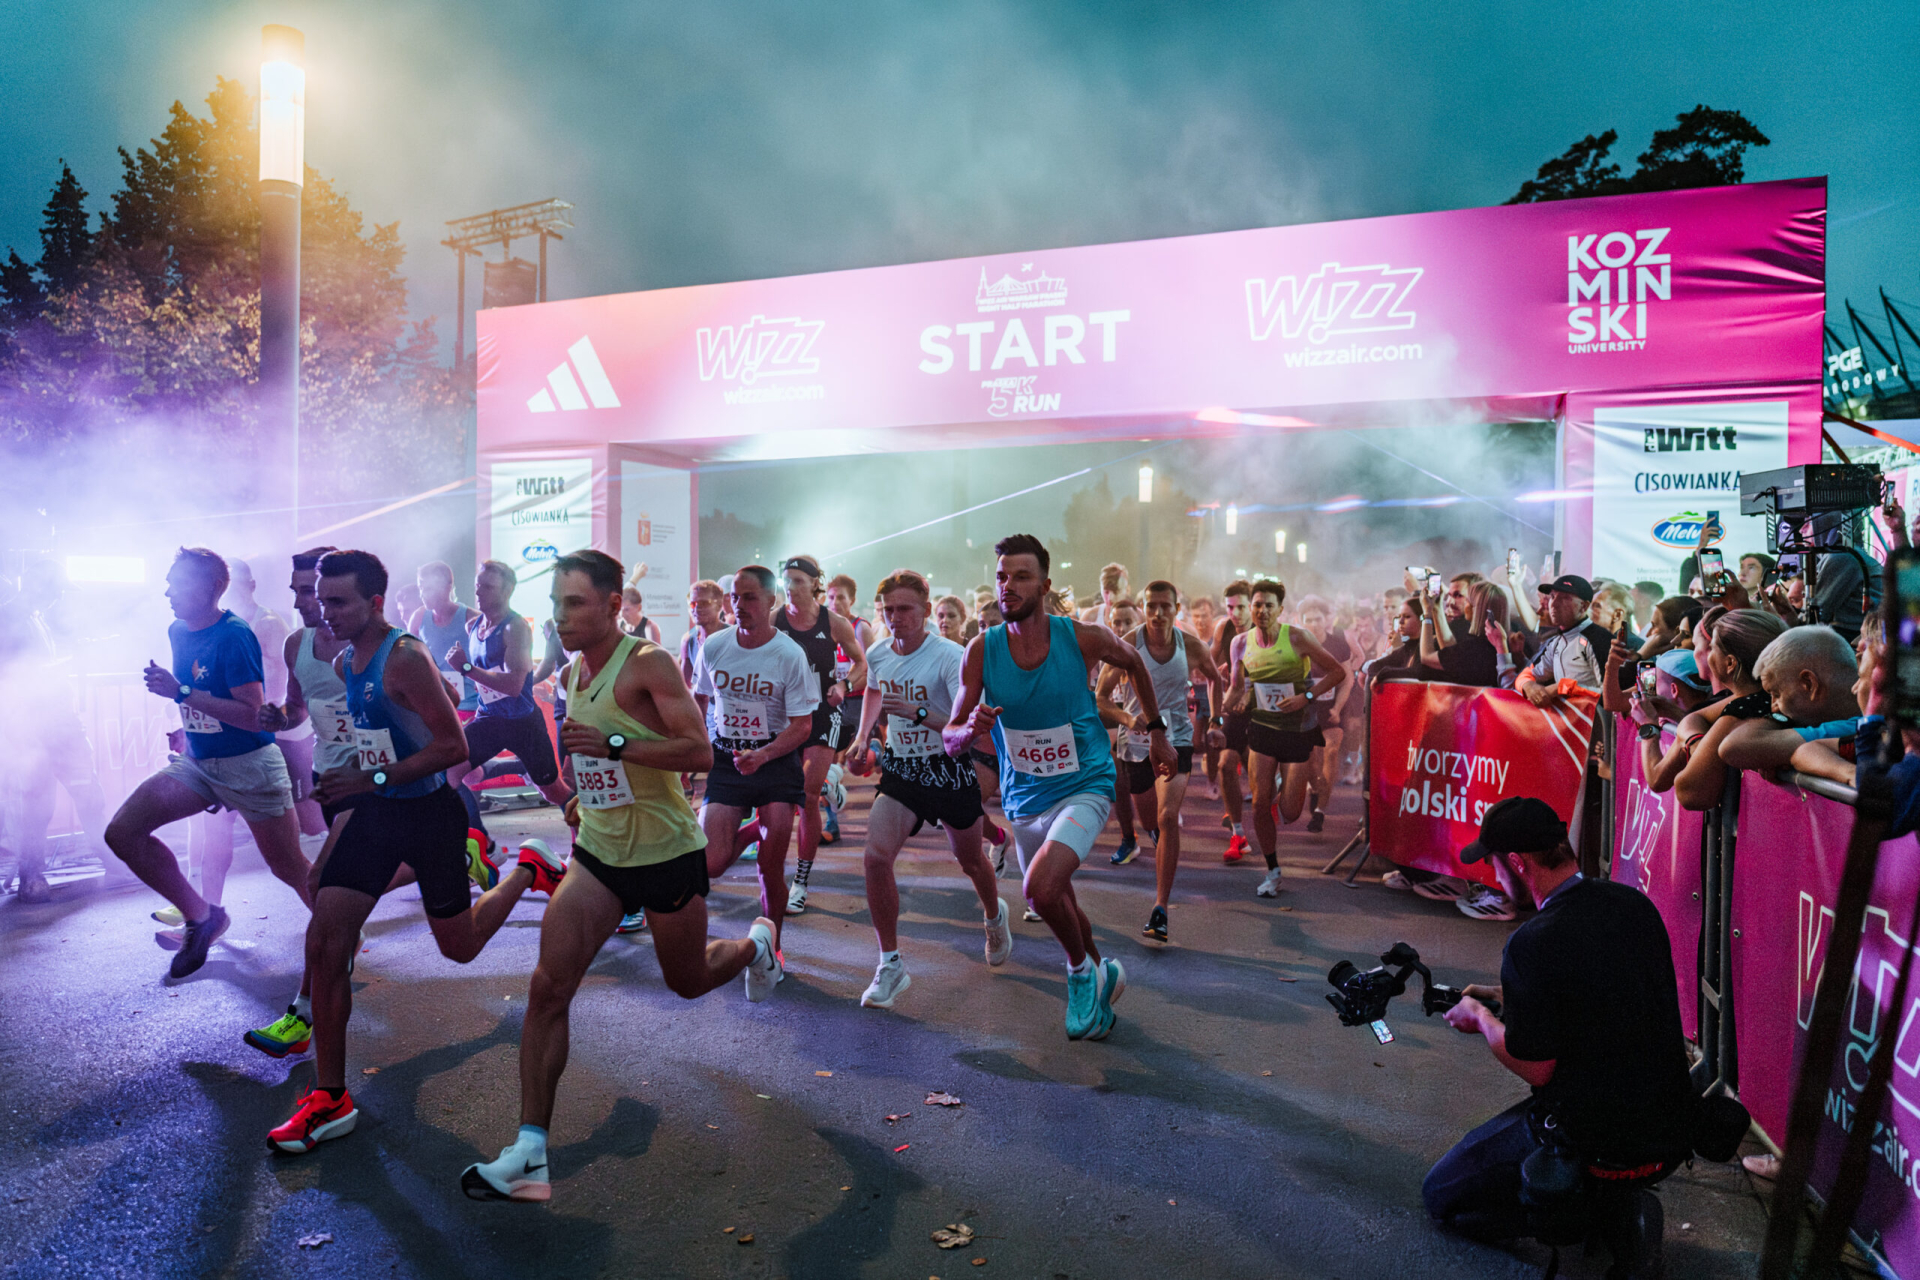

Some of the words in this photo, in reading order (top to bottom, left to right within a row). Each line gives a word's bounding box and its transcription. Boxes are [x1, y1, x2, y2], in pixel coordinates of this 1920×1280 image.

[1568, 227, 1671, 271] KOZ
[1568, 265, 1671, 307] MIN
[1568, 303, 1647, 344] SKI
[918, 309, 1131, 375] START
[1568, 340, 1646, 354] UNIVERSITY
[1283, 343, 1422, 368] wizzair.com
[1828, 346, 1863, 377] PGE
[1823, 364, 1899, 397] ARODOWY
[1013, 393, 1061, 413] RUN
[512, 508, 569, 526] CISOWIANKA
[1660, 523, 1703, 541] Melv
[714, 670, 773, 696] Delia
[879, 678, 927, 701] Dlia
[723, 714, 761, 728] 2224
[897, 730, 929, 745] 1577
[1017, 743, 1070, 763] 4666
[577, 769, 619, 790] 3883
[1407, 739, 1509, 795] tworzymy
[1398, 780, 1467, 823] polski
